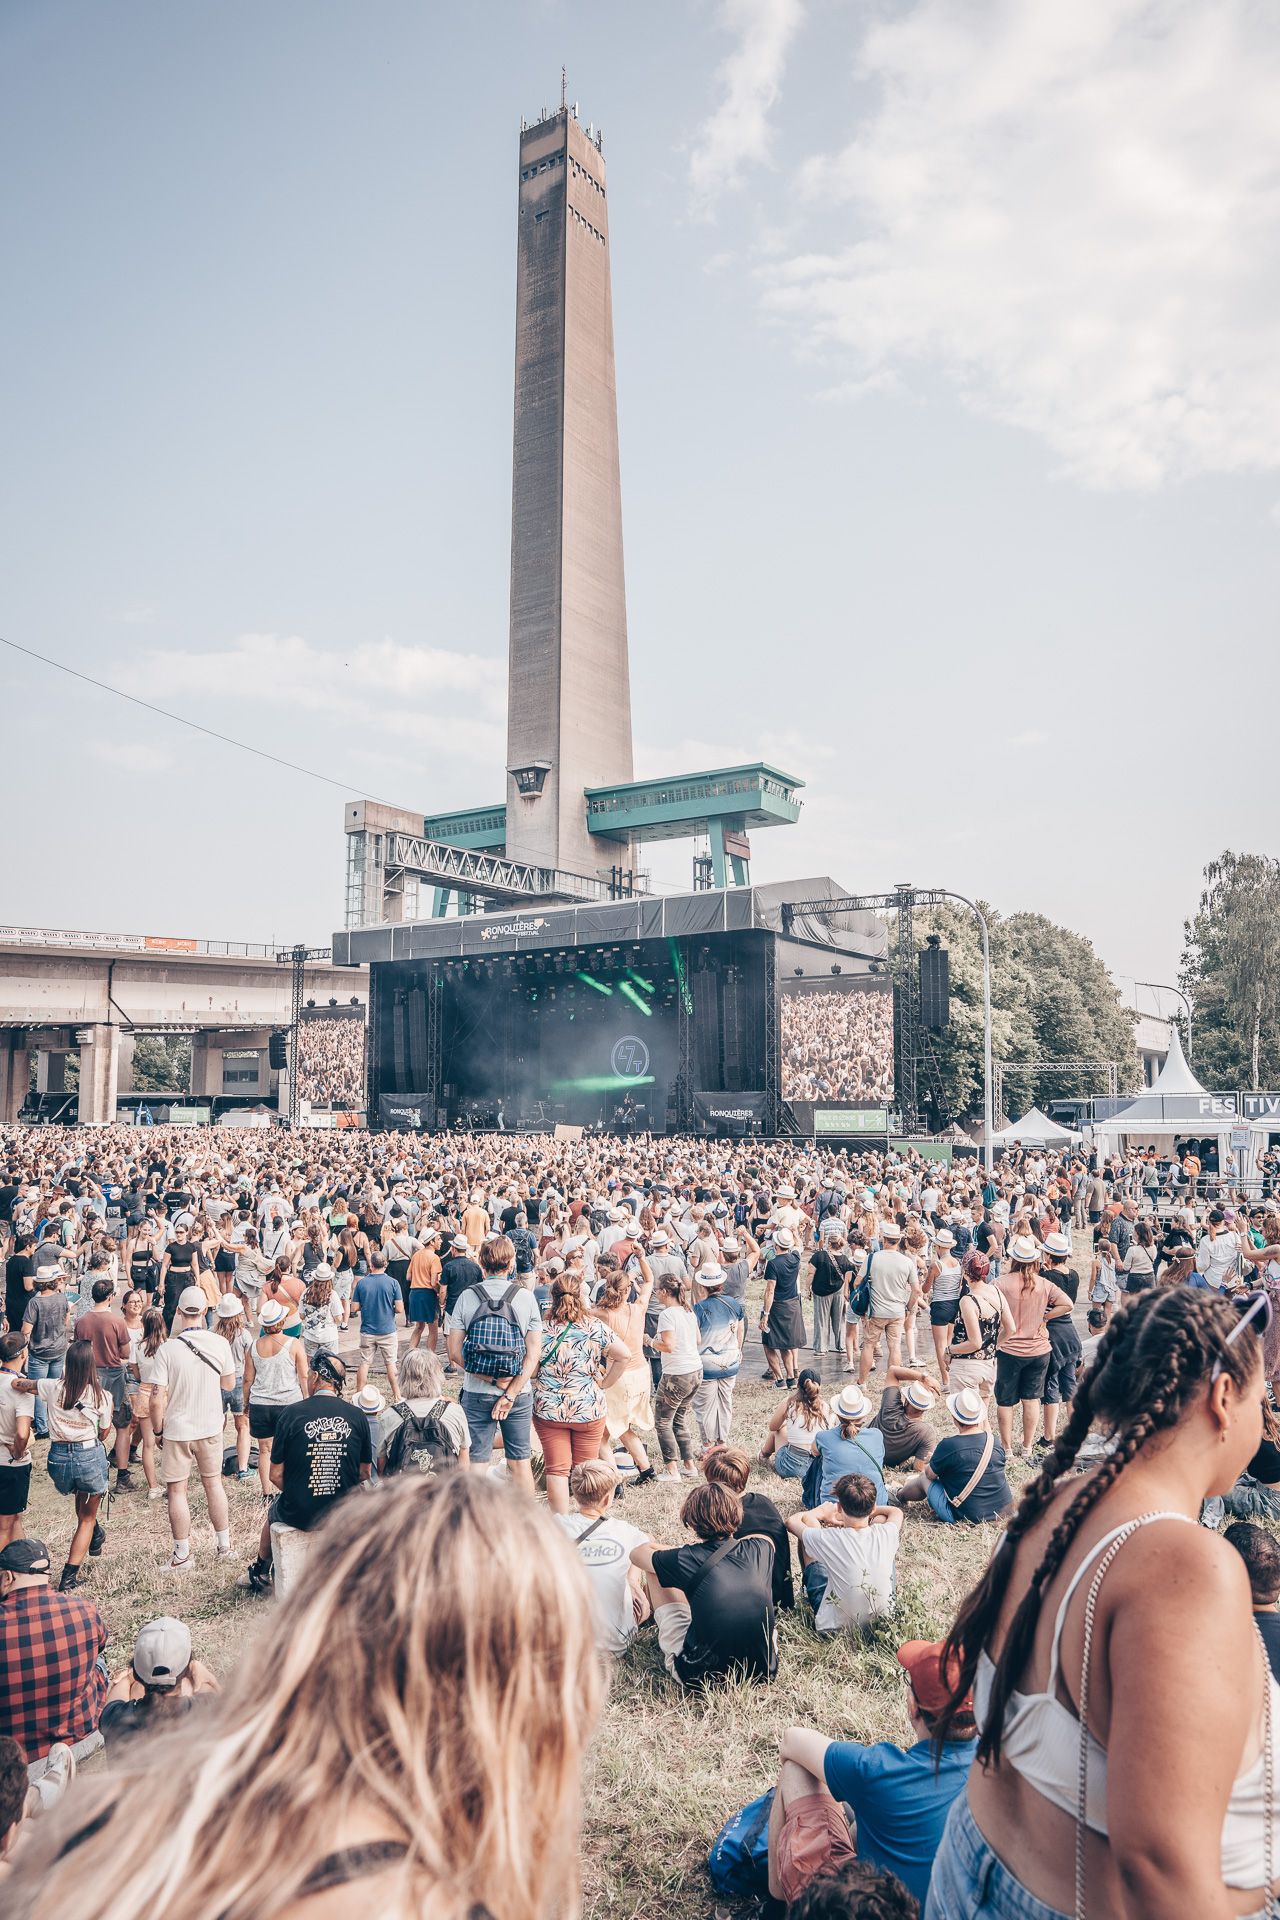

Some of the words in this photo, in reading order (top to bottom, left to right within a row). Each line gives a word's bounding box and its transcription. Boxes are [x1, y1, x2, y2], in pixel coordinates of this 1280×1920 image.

[1199, 1098, 1236, 1114] FES
[1245, 1097, 1280, 1113] TIV
[710, 1109, 753, 1117] RONQUIÈRES
